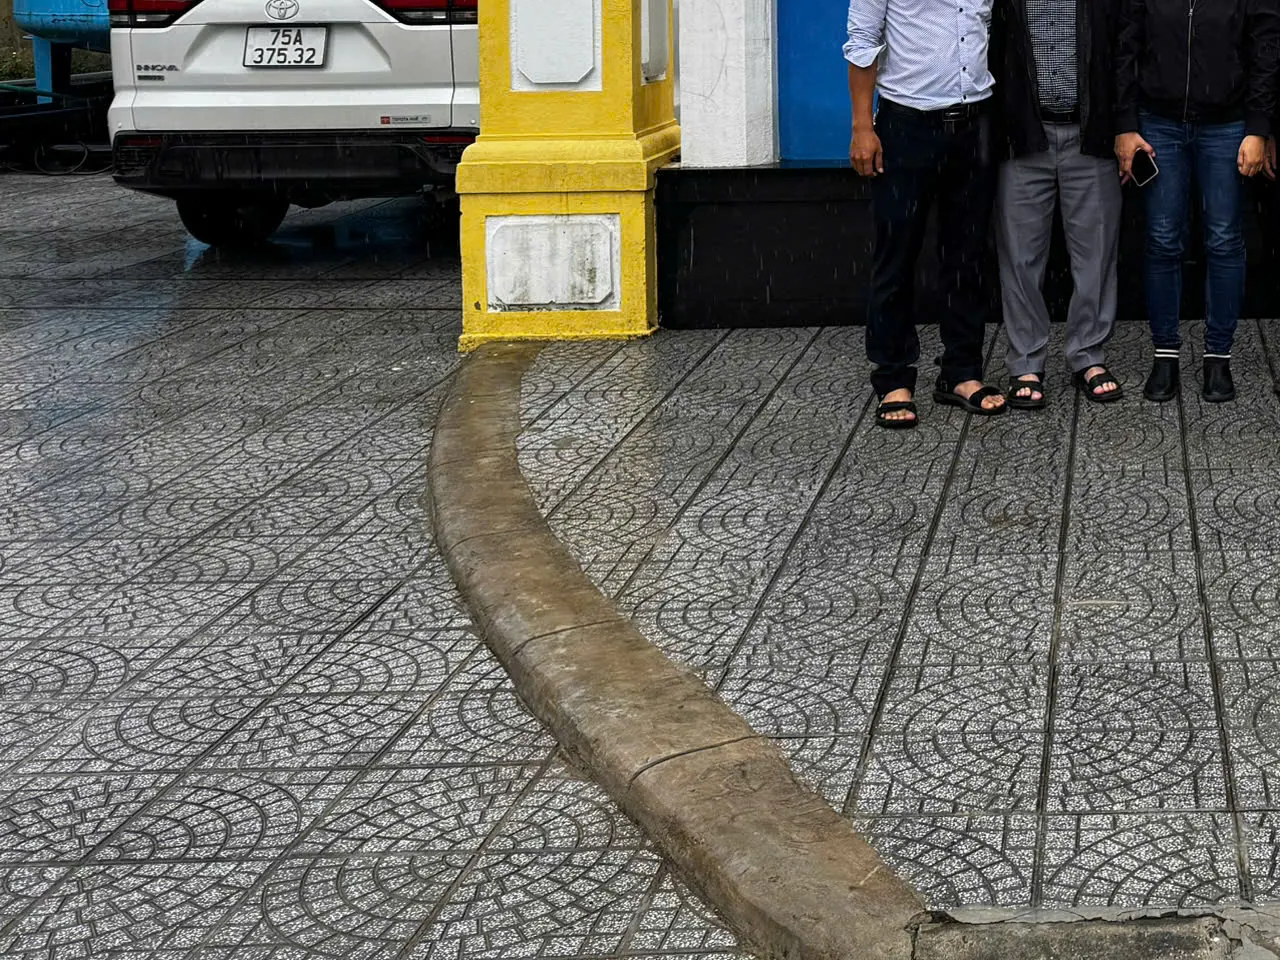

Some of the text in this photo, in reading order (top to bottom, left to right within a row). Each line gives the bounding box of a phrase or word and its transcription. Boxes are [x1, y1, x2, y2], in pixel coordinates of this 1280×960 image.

[270, 29, 303, 46] 75A
[253, 47, 316, 64] 375.32
[136, 64, 180, 72] INNOVA
